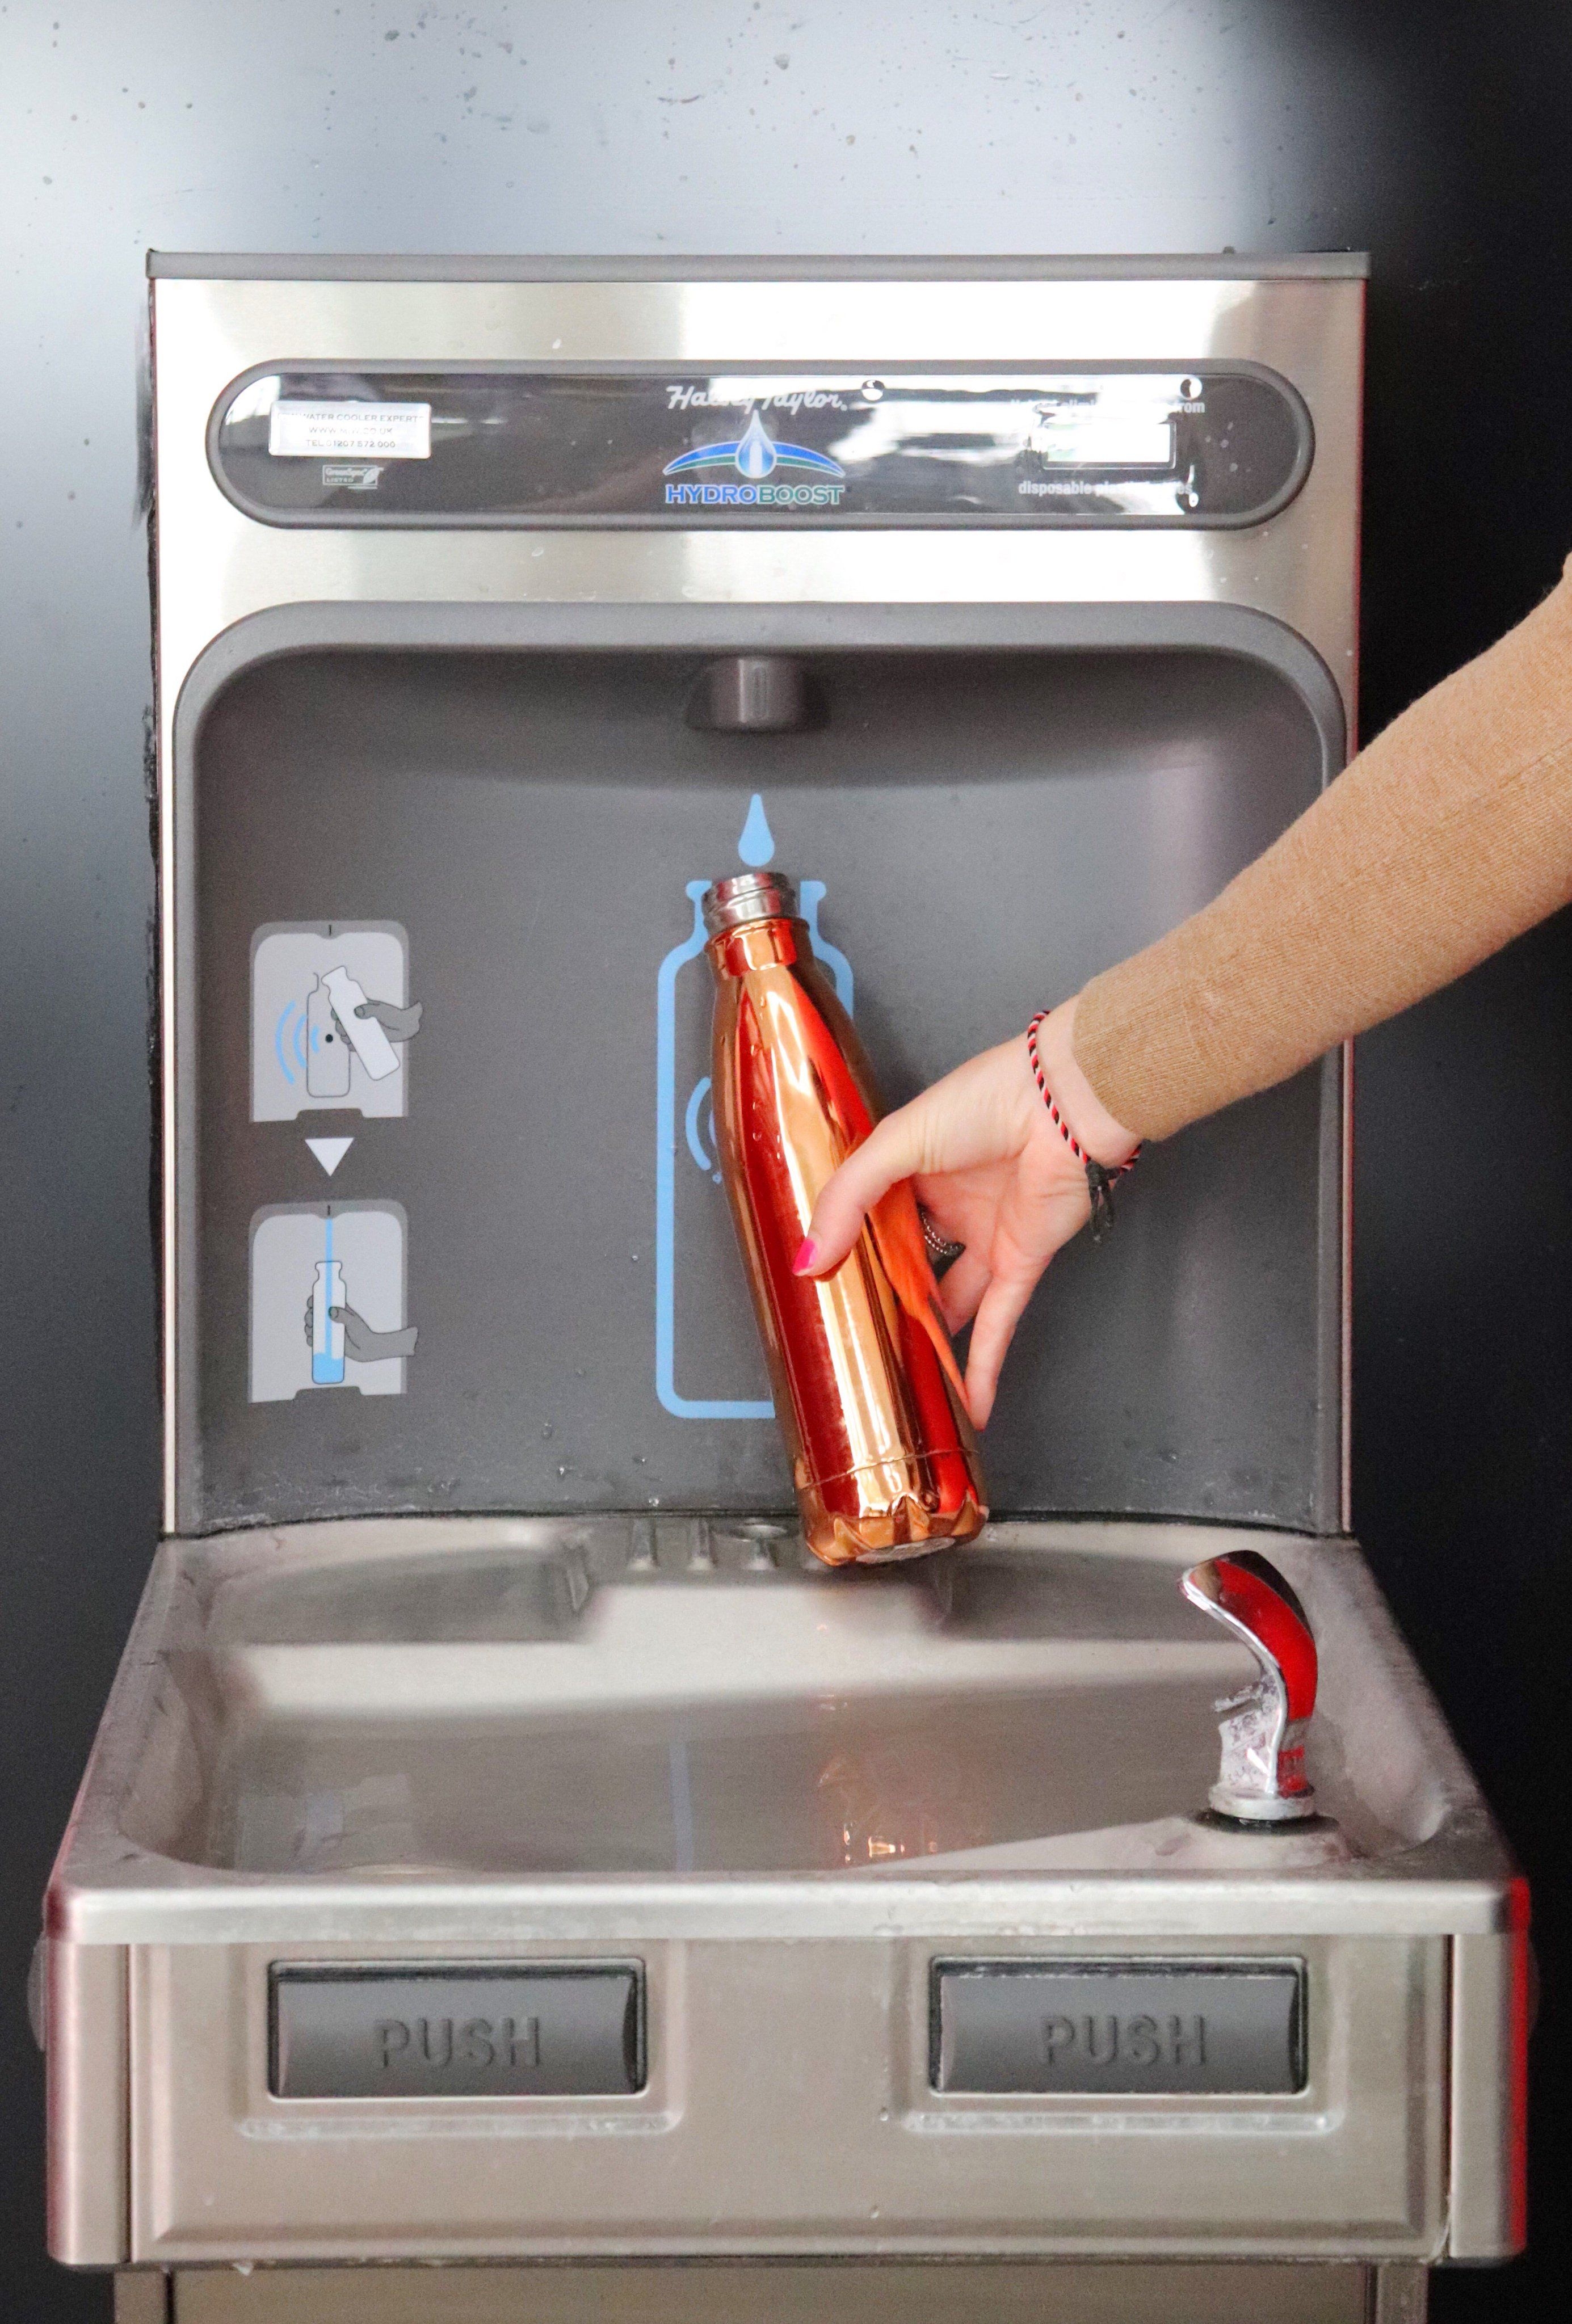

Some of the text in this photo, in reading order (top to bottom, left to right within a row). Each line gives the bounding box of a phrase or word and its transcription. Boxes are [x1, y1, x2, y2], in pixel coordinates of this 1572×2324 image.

[666, 385, 754, 415] Hay
[1176, 399, 1205, 414] rom
[665, 484, 845, 504] HYDROBOOST
[1018, 481, 1093, 496] disposable
[373, 2016, 541, 2068] PUSH
[1041, 2015, 1207, 2065] PUSH
